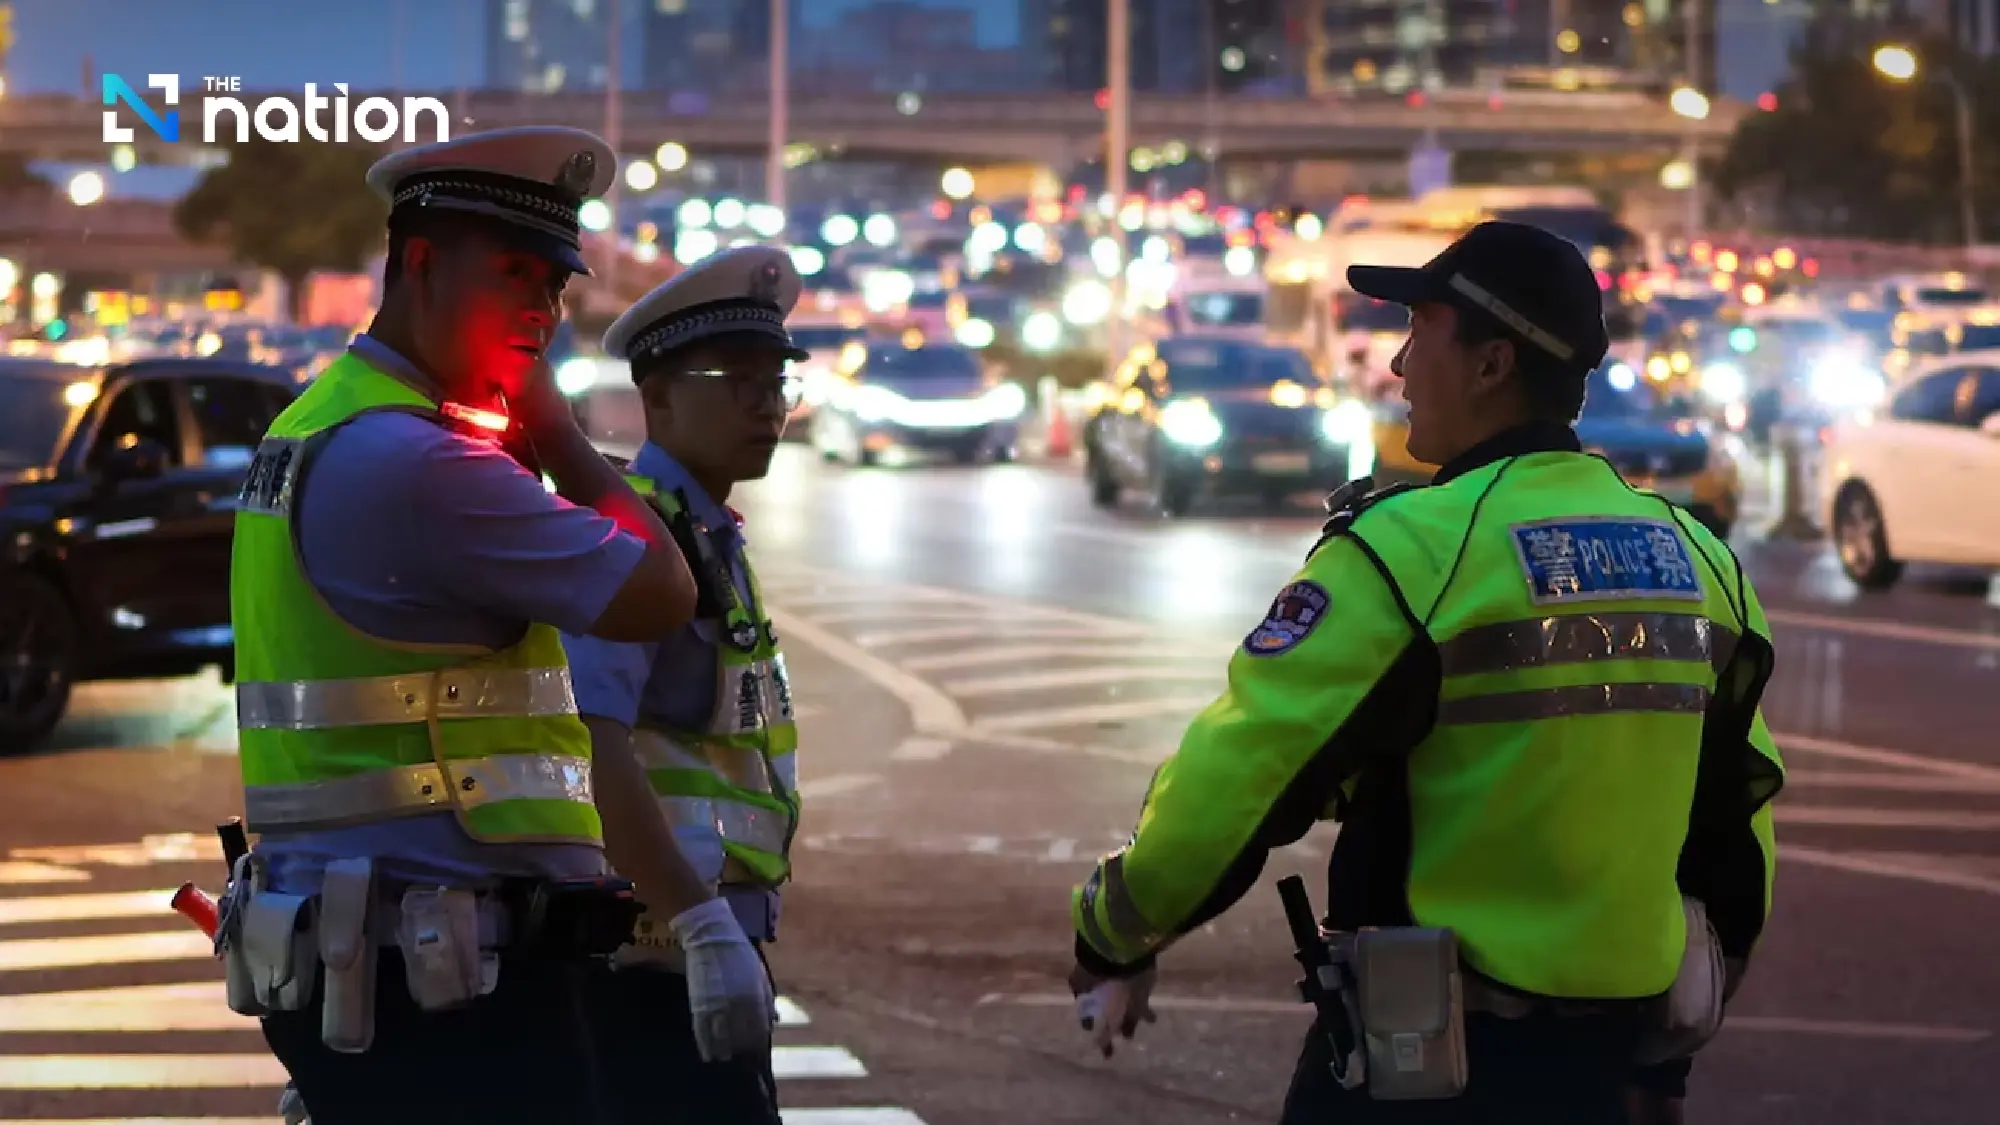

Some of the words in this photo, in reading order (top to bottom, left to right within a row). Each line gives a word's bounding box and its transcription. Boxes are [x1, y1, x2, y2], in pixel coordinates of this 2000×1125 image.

[1525, 527, 1580, 597] 警
[1577, 536, 1652, 575] POLICE
[1645, 528, 1691, 586] 察
